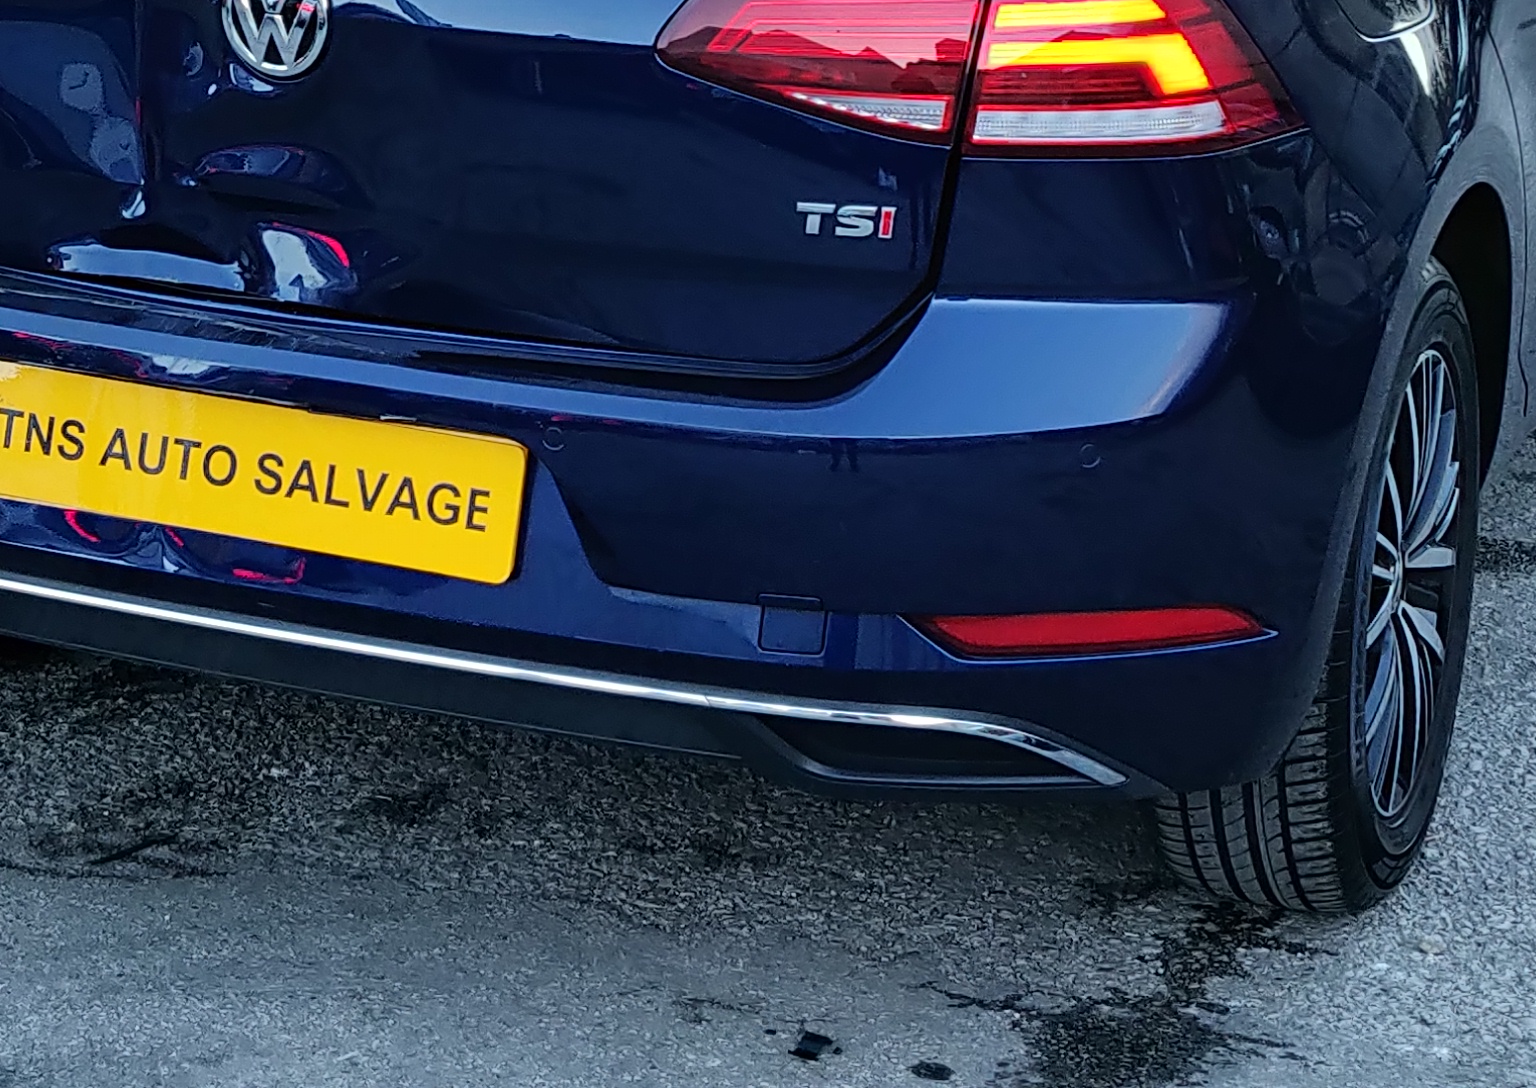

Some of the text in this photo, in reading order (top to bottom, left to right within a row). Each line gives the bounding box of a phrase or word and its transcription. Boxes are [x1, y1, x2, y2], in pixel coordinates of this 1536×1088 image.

[796, 201, 897, 239] TSI
[99, 428, 238, 487] AUTO
[254, 453, 491, 533] SALVAGE
